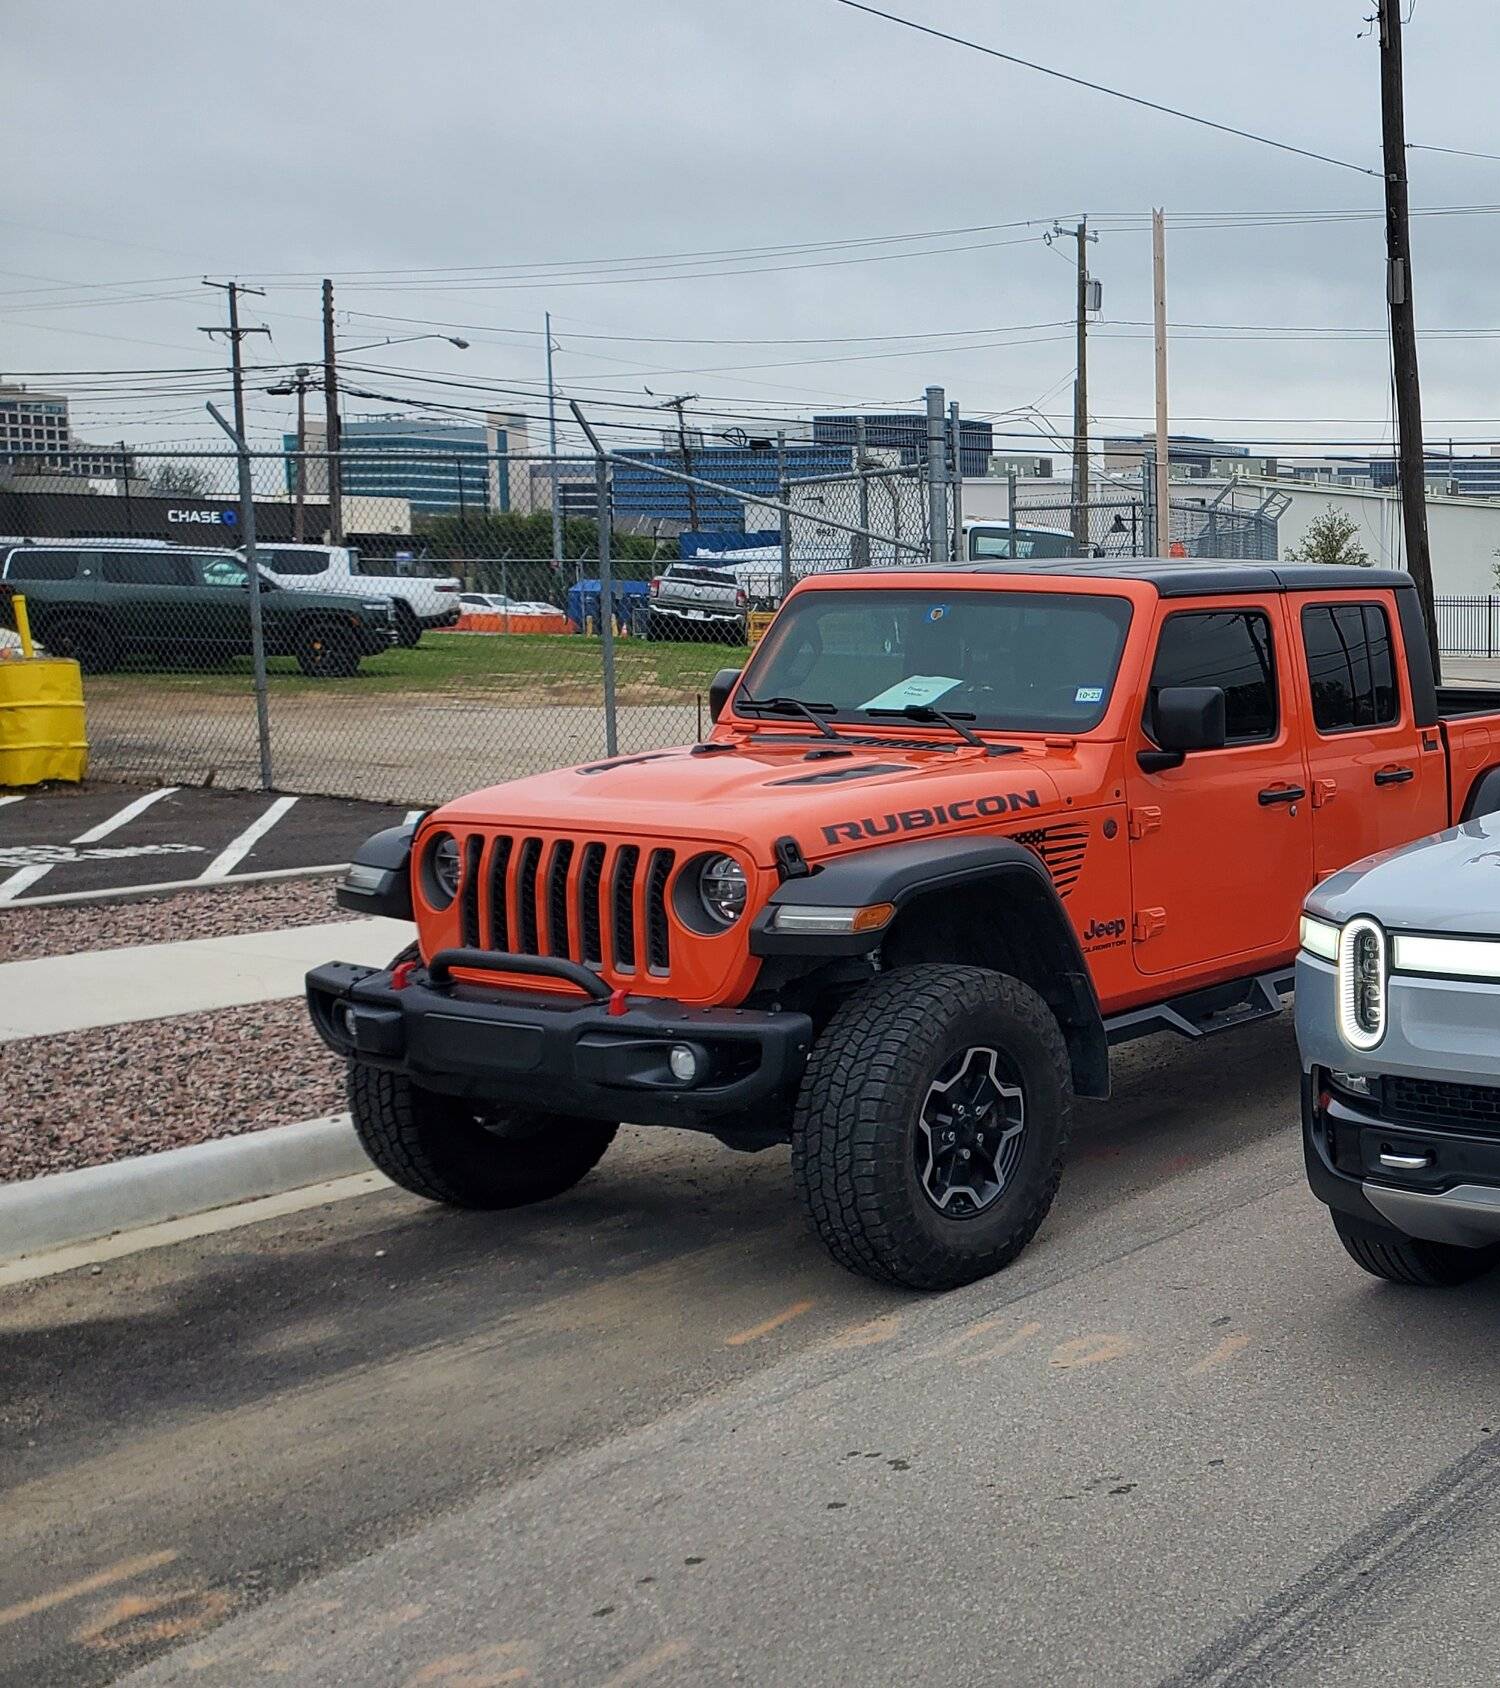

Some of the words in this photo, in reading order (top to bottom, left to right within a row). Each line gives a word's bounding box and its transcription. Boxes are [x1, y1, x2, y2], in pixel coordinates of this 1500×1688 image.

[167, 509, 221, 524] CHASE
[820, 789, 1041, 846] RUBICON
[1083, 918, 1126, 940] Jeep
[1081, 940, 1127, 954] GLADIATOR
